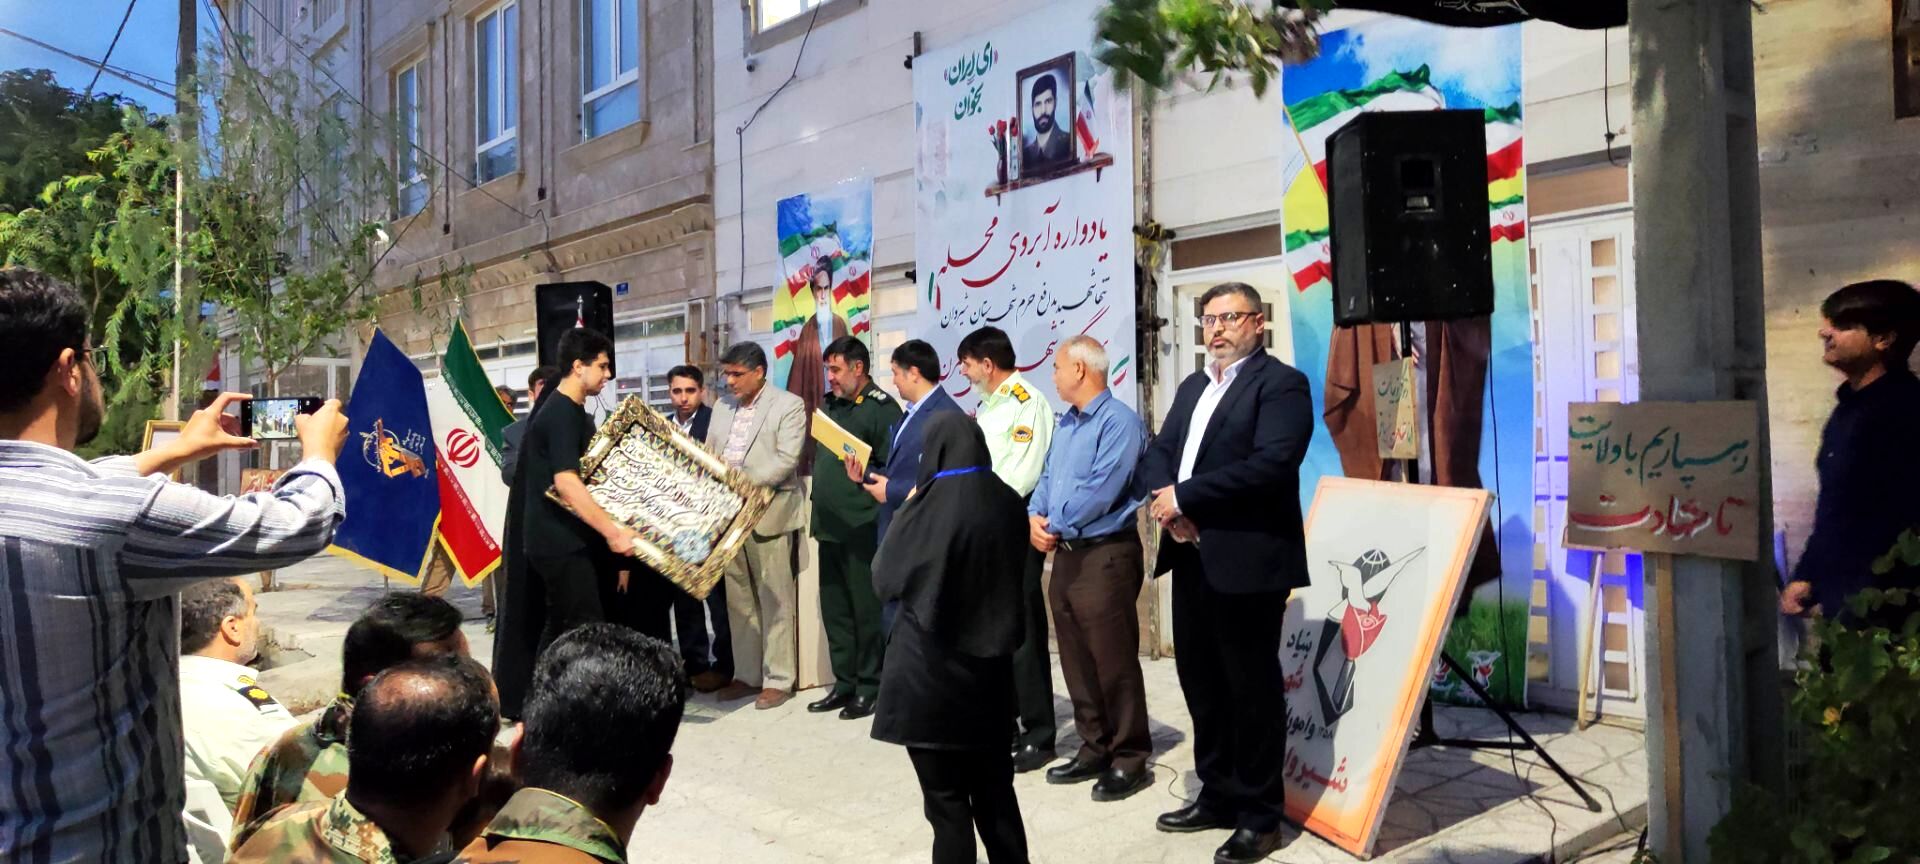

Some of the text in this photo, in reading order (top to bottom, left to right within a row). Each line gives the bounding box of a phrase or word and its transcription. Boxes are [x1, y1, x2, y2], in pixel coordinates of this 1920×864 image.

[954, 82, 984, 121] بخوان
[937, 196, 1109, 288] یادواره آبروی محله
[940, 292, 969, 329] شیروان
[969, 284, 1017, 327] شهرستان
[1015, 293, 1036, 329] حرم
[1715, 496, 1745, 537] تا
[1286, 628, 1313, 660] بنیاد
[1283, 746, 1348, 794] شیروا
